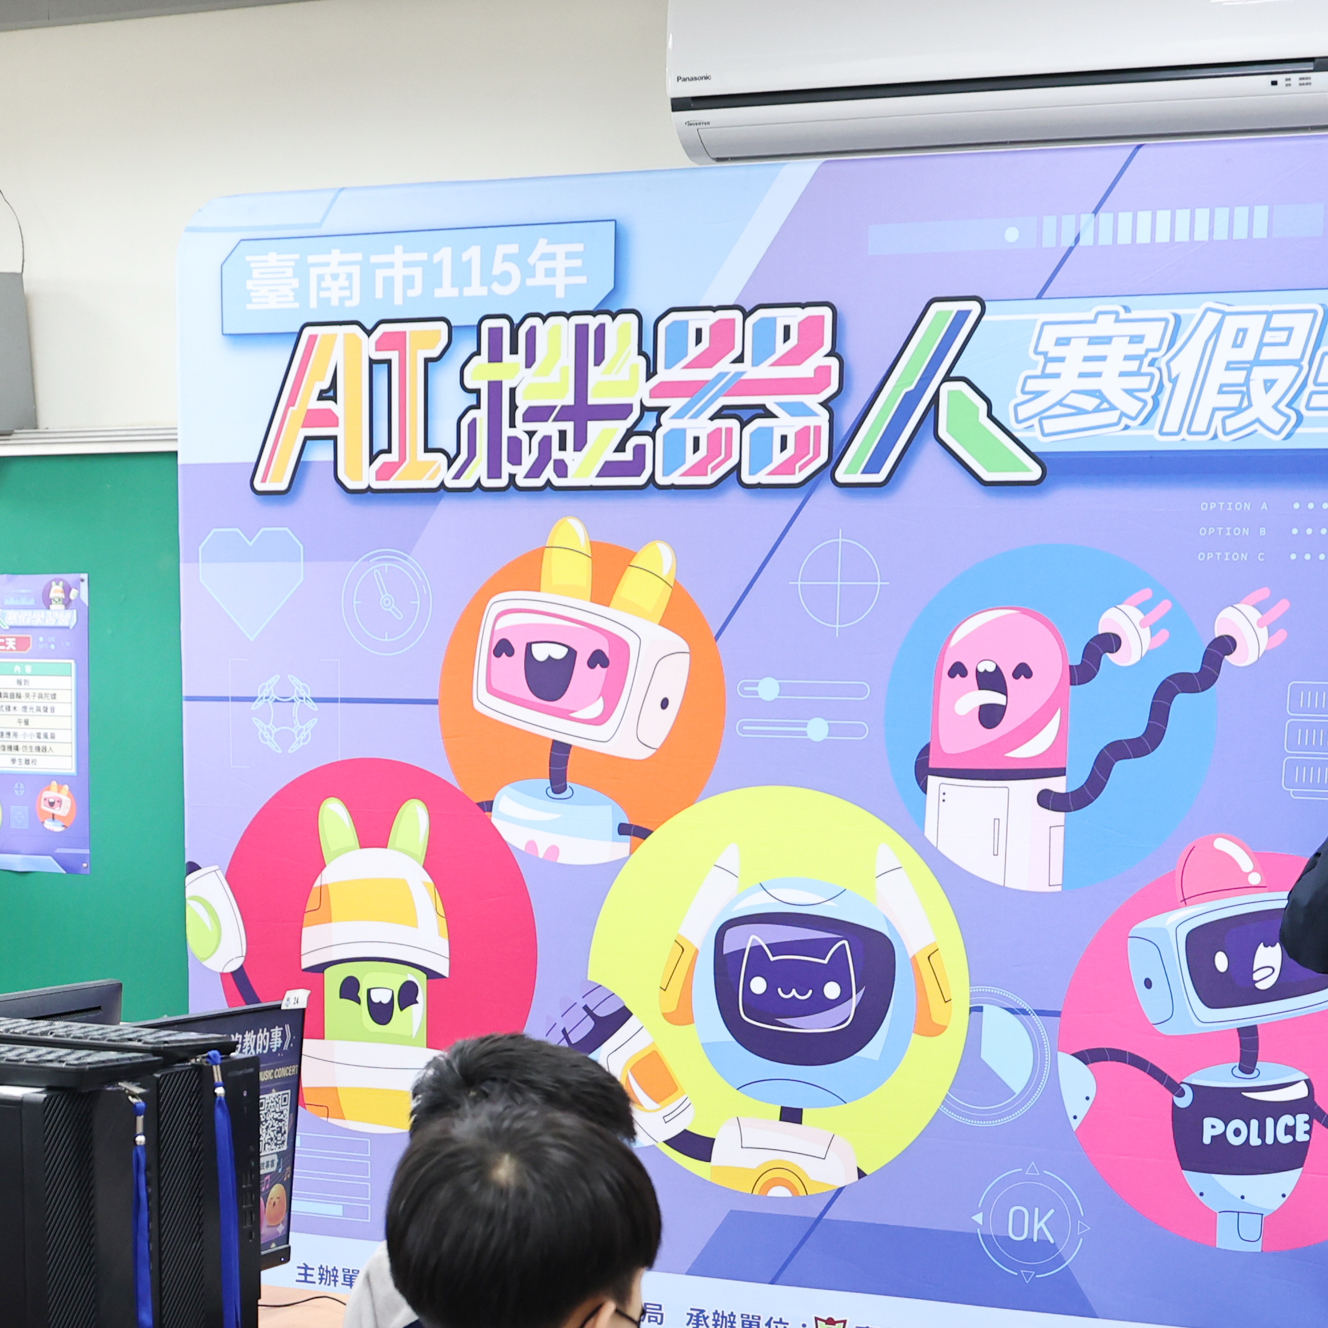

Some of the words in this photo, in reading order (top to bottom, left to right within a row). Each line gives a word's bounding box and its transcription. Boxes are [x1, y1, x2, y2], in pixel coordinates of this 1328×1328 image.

[676, 73, 712, 83] Panasonic
[245, 238, 589, 311] 臺南市115年
[251, 296, 1047, 493] AI機器人
[1200, 501, 1251, 511] OPTION
[1260, 502, 1268, 511] A
[1199, 527, 1250, 536] OPTION
[1259, 528, 1266, 536] B
[1197, 552, 1248, 562] OPTION
[1257, 553, 1265, 562] C
[259, 1069, 274, 1082] USIC
[1201, 1114, 1312, 1146] POLICE
[1007, 1205, 1056, 1244] OK
